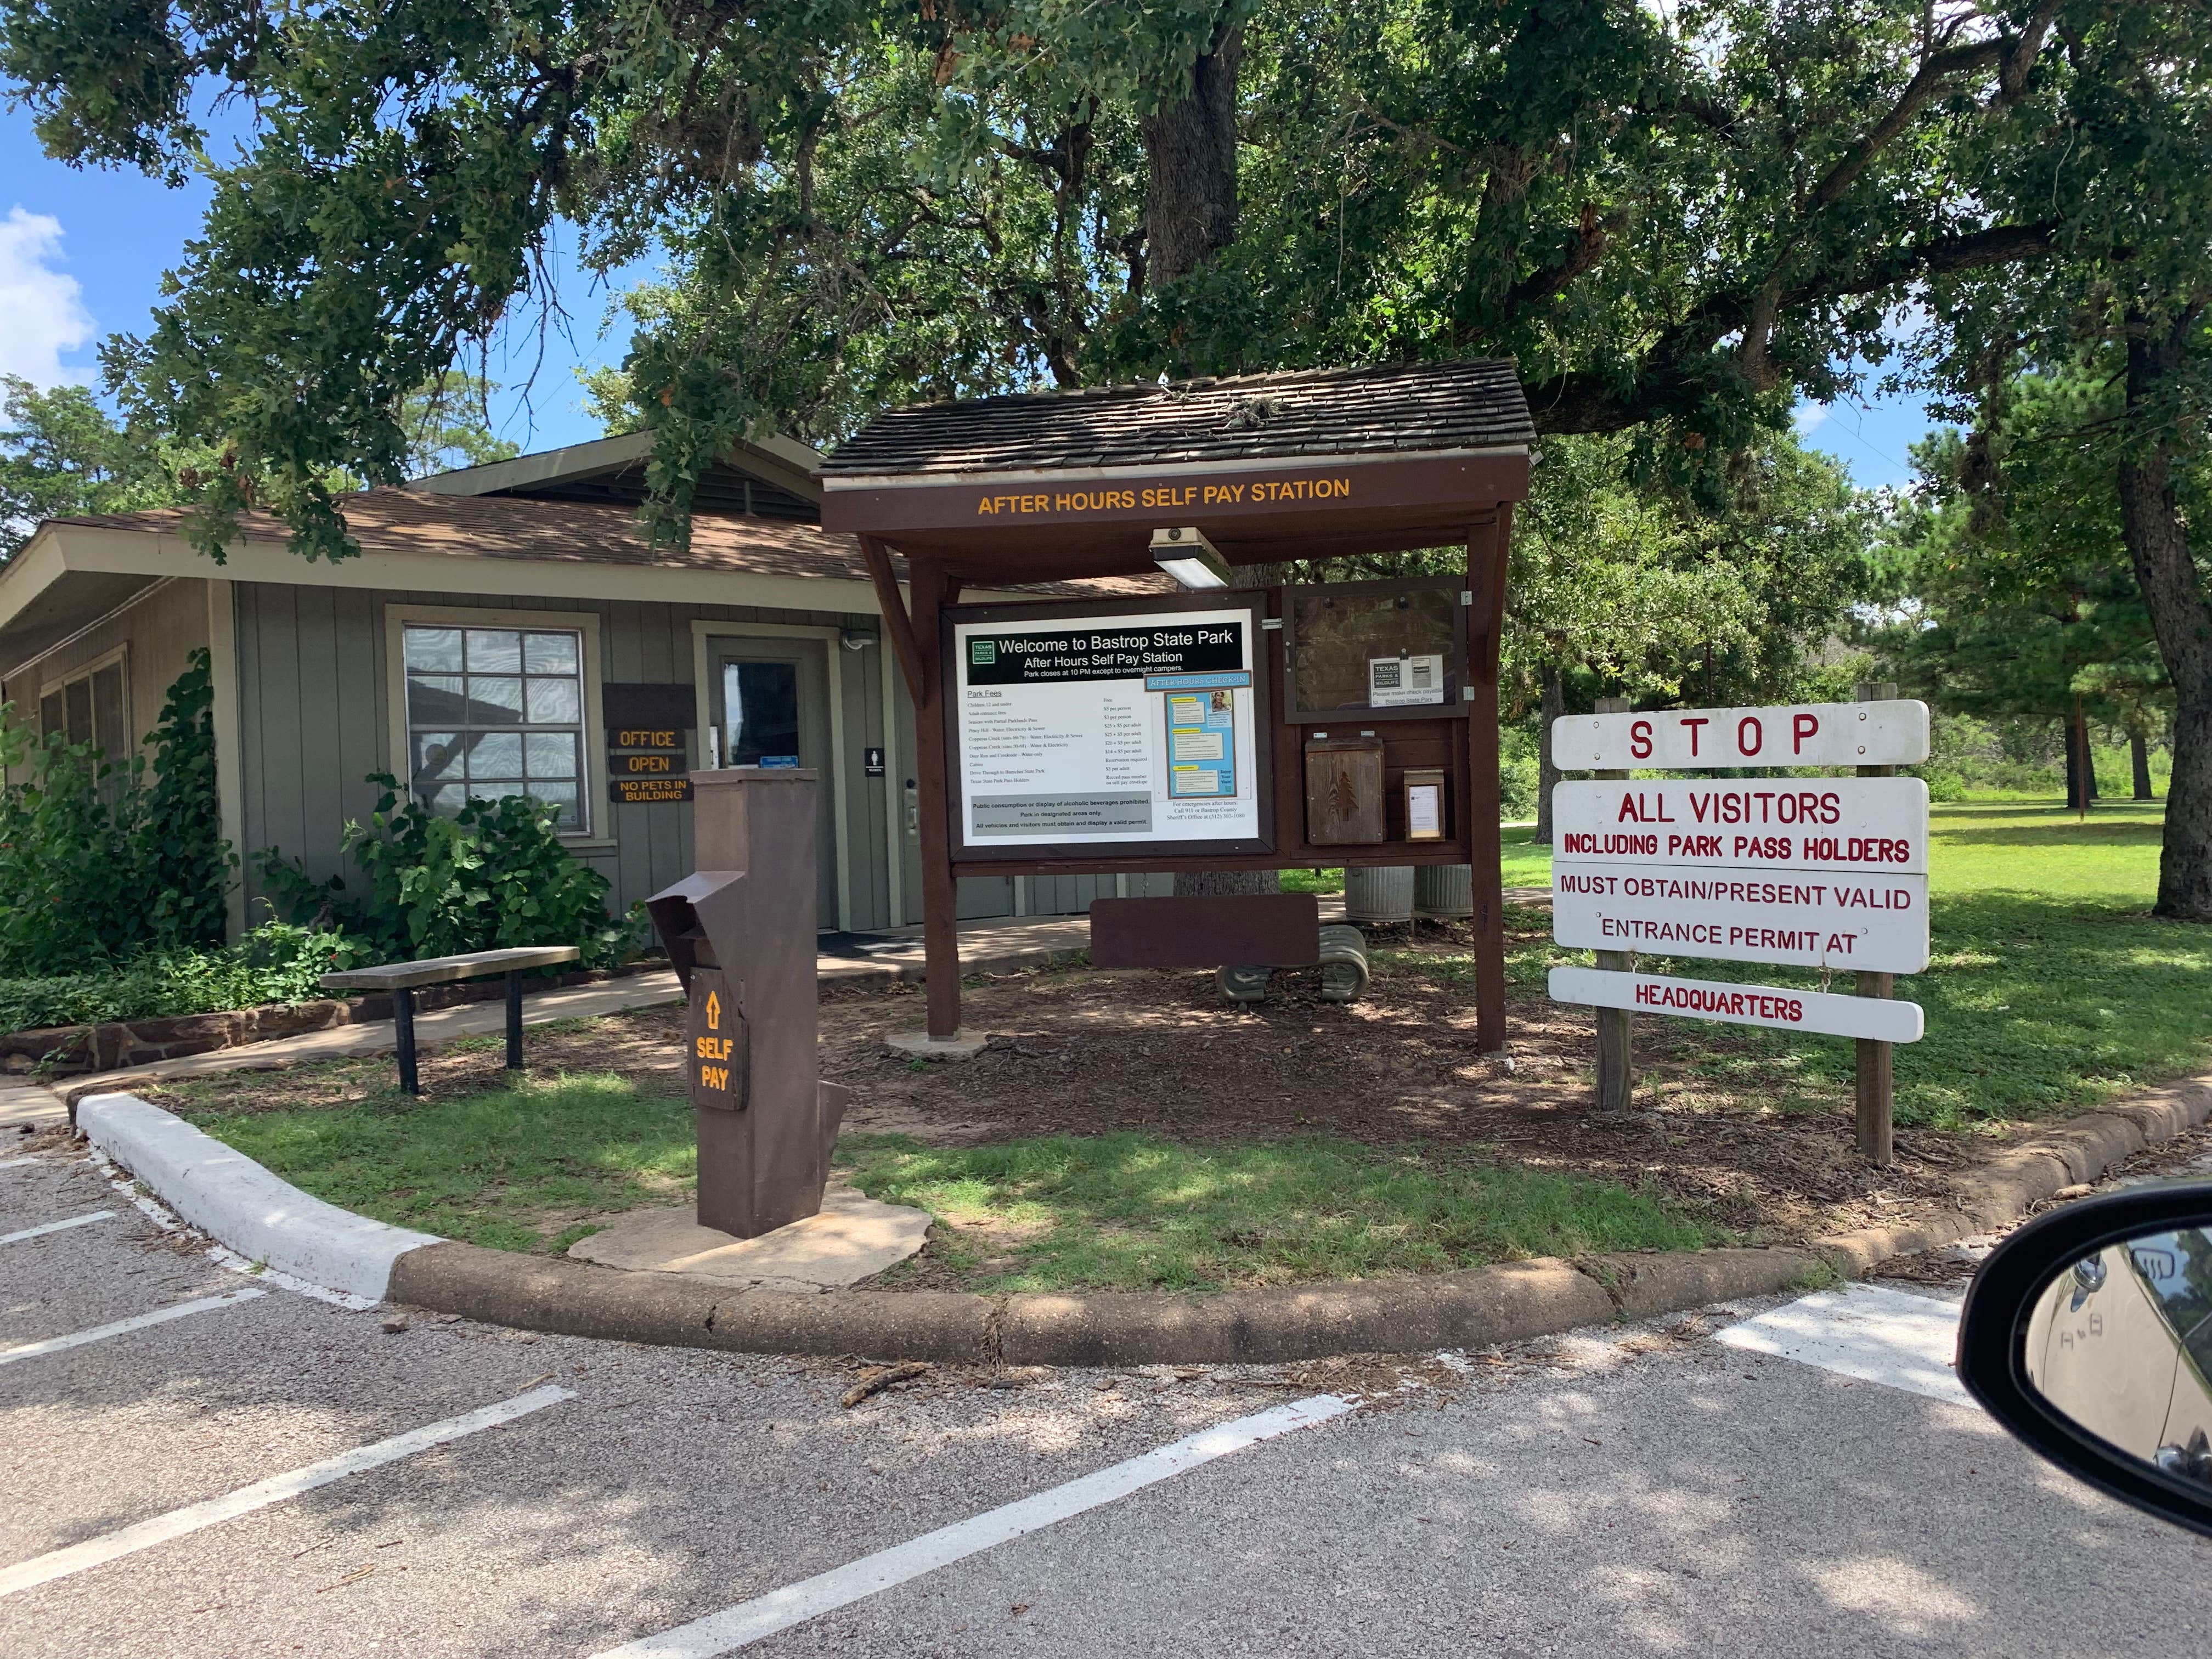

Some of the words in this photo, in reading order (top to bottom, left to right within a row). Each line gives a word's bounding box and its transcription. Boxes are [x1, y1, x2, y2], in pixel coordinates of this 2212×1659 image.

[978, 494, 1049, 514] AFTER
[1056, 490, 1135, 510] HOURS
[1141, 487, 1197, 507] SELF
[1204, 484, 1245, 504] PAY
[1251, 479, 1350, 501] STATION
[998, 639, 1068, 653] Welcome
[1072, 637, 1086, 650] to
[1091, 635, 1148, 651] Bastrop
[1153, 633, 1193, 646] State
[1198, 629, 1233, 644] Park
[1024, 657, 1052, 668] After
[1055, 656, 1088, 667] Hours
[1092, 654, 1114, 665] Self
[1117, 653, 1139, 666] Pay
[1141, 652, 1182, 663] Station
[1122, 666, 1153, 675] overnight
[1206, 675, 1246, 684] CHECK-IN
[620, 731, 675, 747] OFFICE
[629, 756, 669, 772] OPEN
[620, 782, 638, 791] NO
[641, 781, 672, 791] PETS
[674, 781, 687, 789] IN
[625, 790, 681, 801] BUILDING
[1618, 792, 1675, 823] ALL
[1689, 792, 1839, 824] VISITORS
[1564, 834, 1658, 855] INCLUDING
[1668, 834, 1723, 856] PARK
[1734, 836, 1791, 860] PASS
[1803, 838, 1909, 863] HOLDERS
[1560, 875, 1618, 895] MUST
[1624, 877, 1826, 905] OBTAIN/PRESENT
[1833, 887, 1910, 910] VALID
[1601, 918, 1721, 944] ENTRANCE
[1729, 927, 1819, 951] PERMIT
[1826, 933, 1857, 953] AT
[1636, 985, 1802, 1022] HEADQUARTERS
[697, 1036, 733, 1061] SELF
[702, 1065, 729, 1091] PAY
